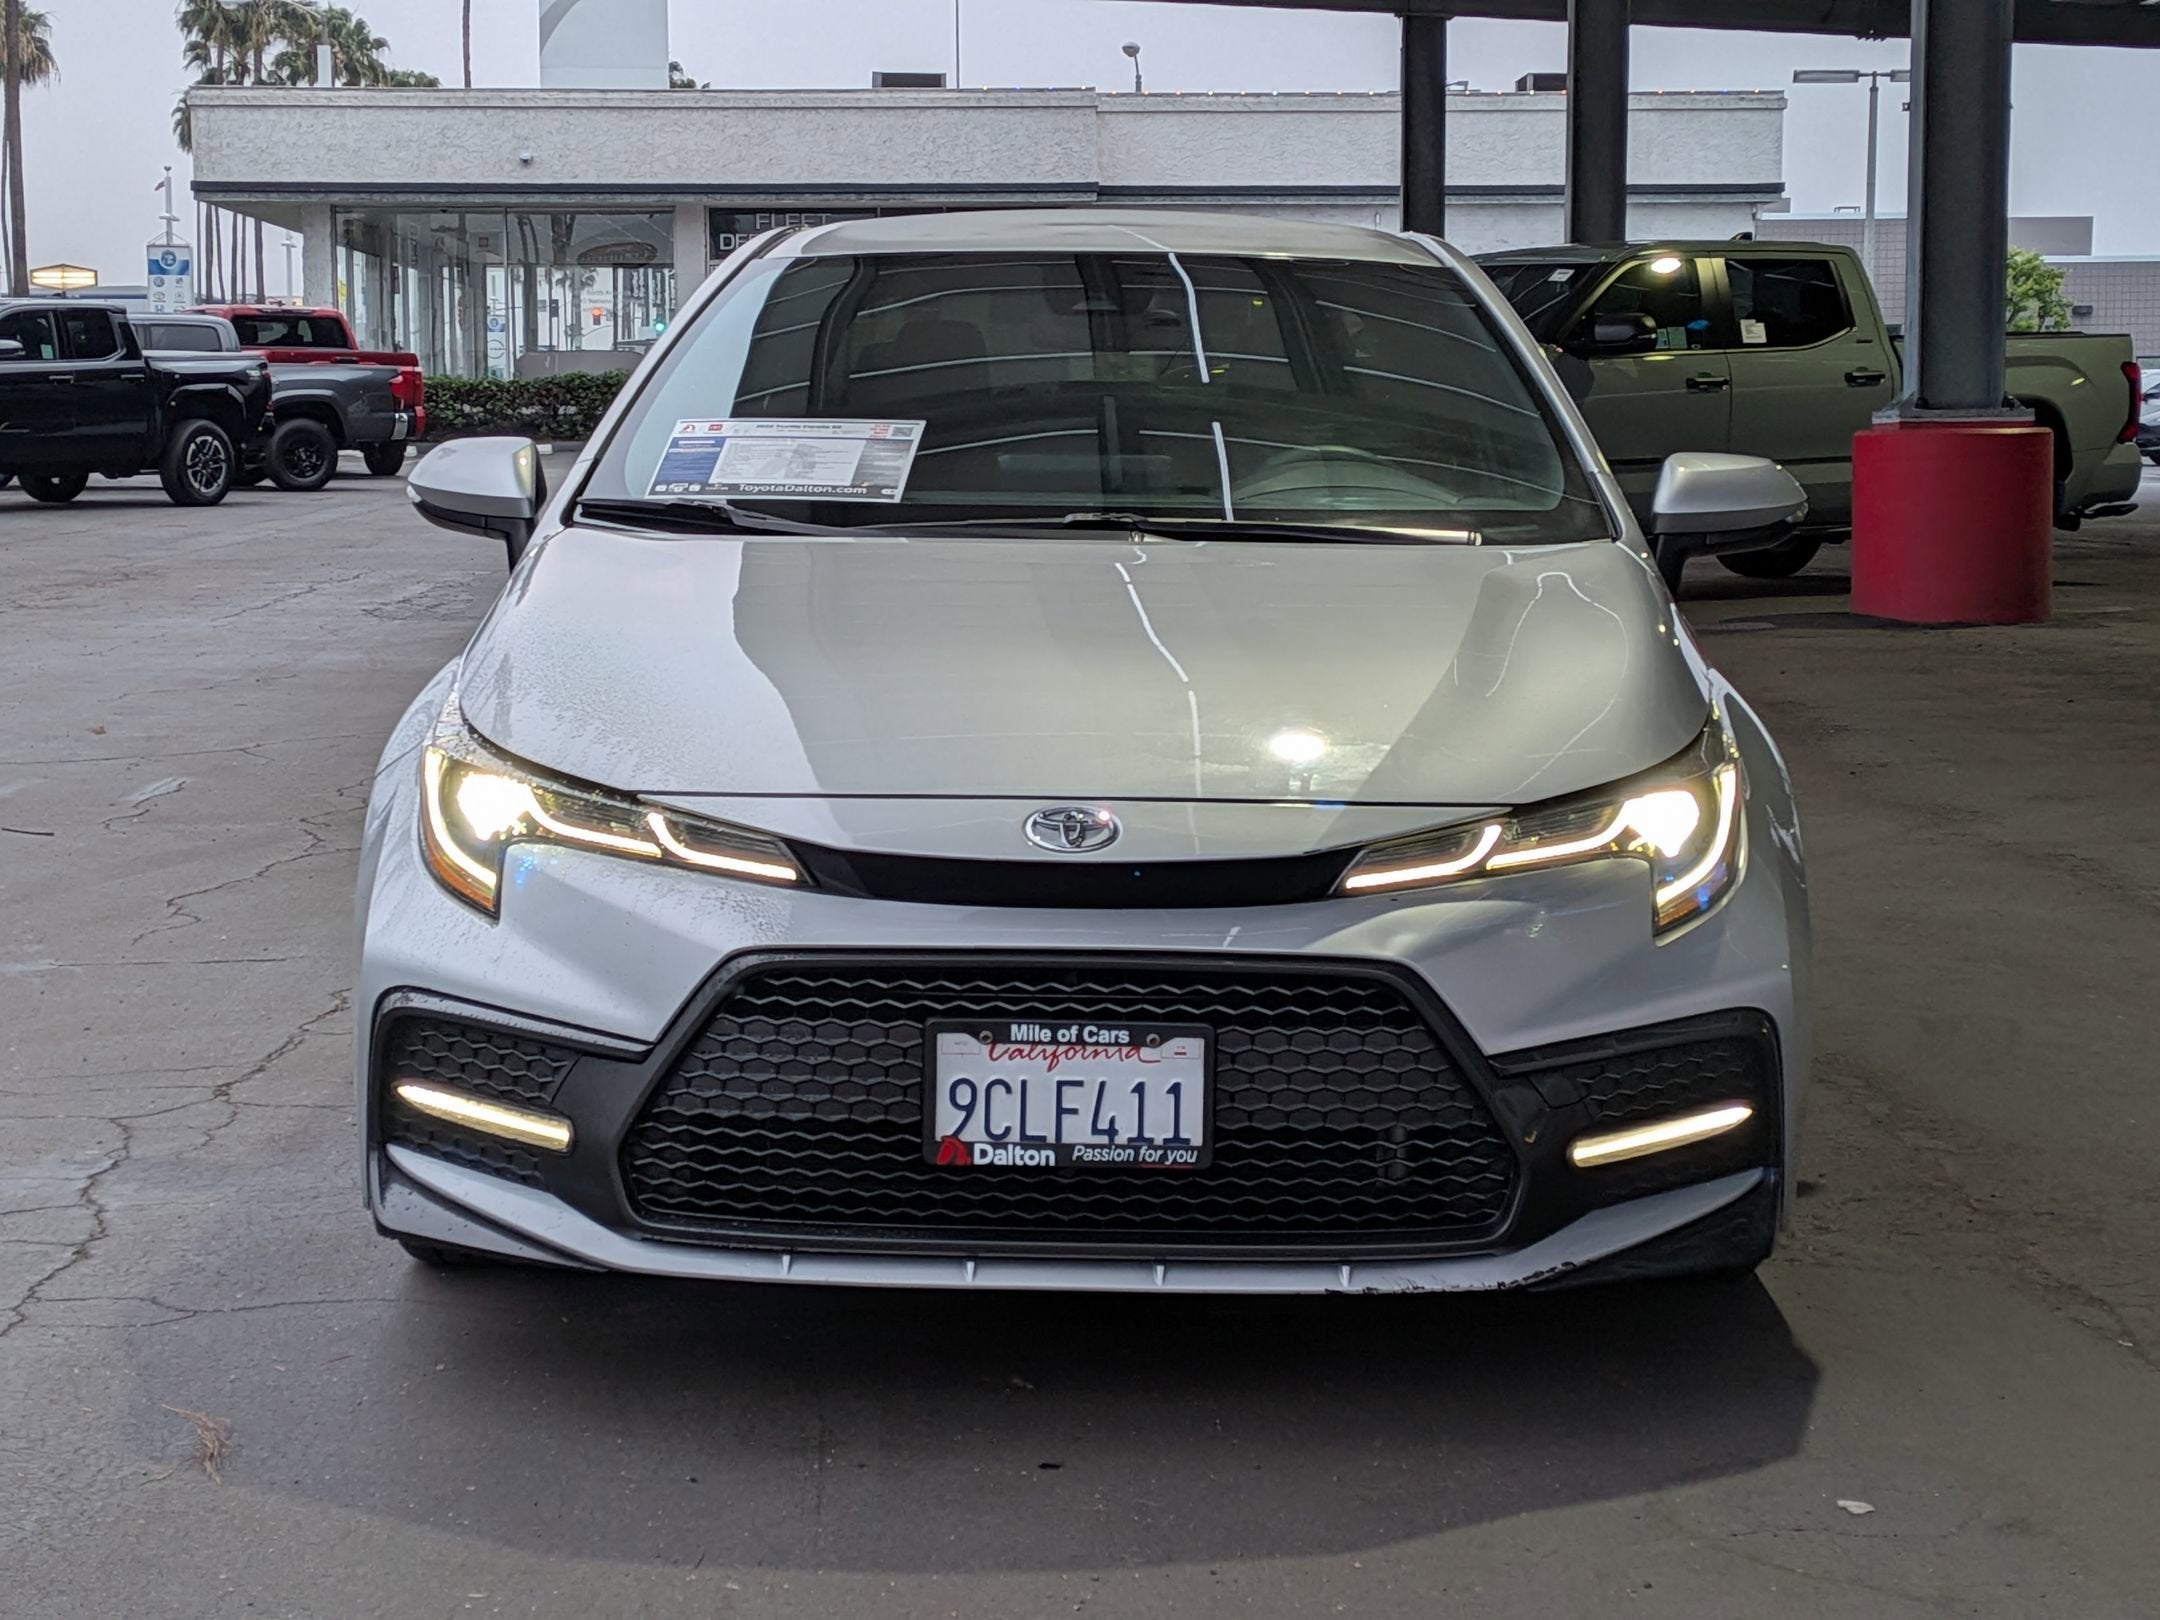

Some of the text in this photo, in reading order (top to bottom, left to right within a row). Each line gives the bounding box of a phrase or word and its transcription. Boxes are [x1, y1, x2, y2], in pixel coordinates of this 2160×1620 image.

[738, 483, 868, 495] ToyotaDalton.com
[1010, 1023, 1130, 1044] Mile of Cars
[988, 1042, 1161, 1073] California
[948, 1077, 1192, 1146] 9CLF411
[973, 1143, 1056, 1167] Dalton
[1072, 1145, 1198, 1165] Passion for you
